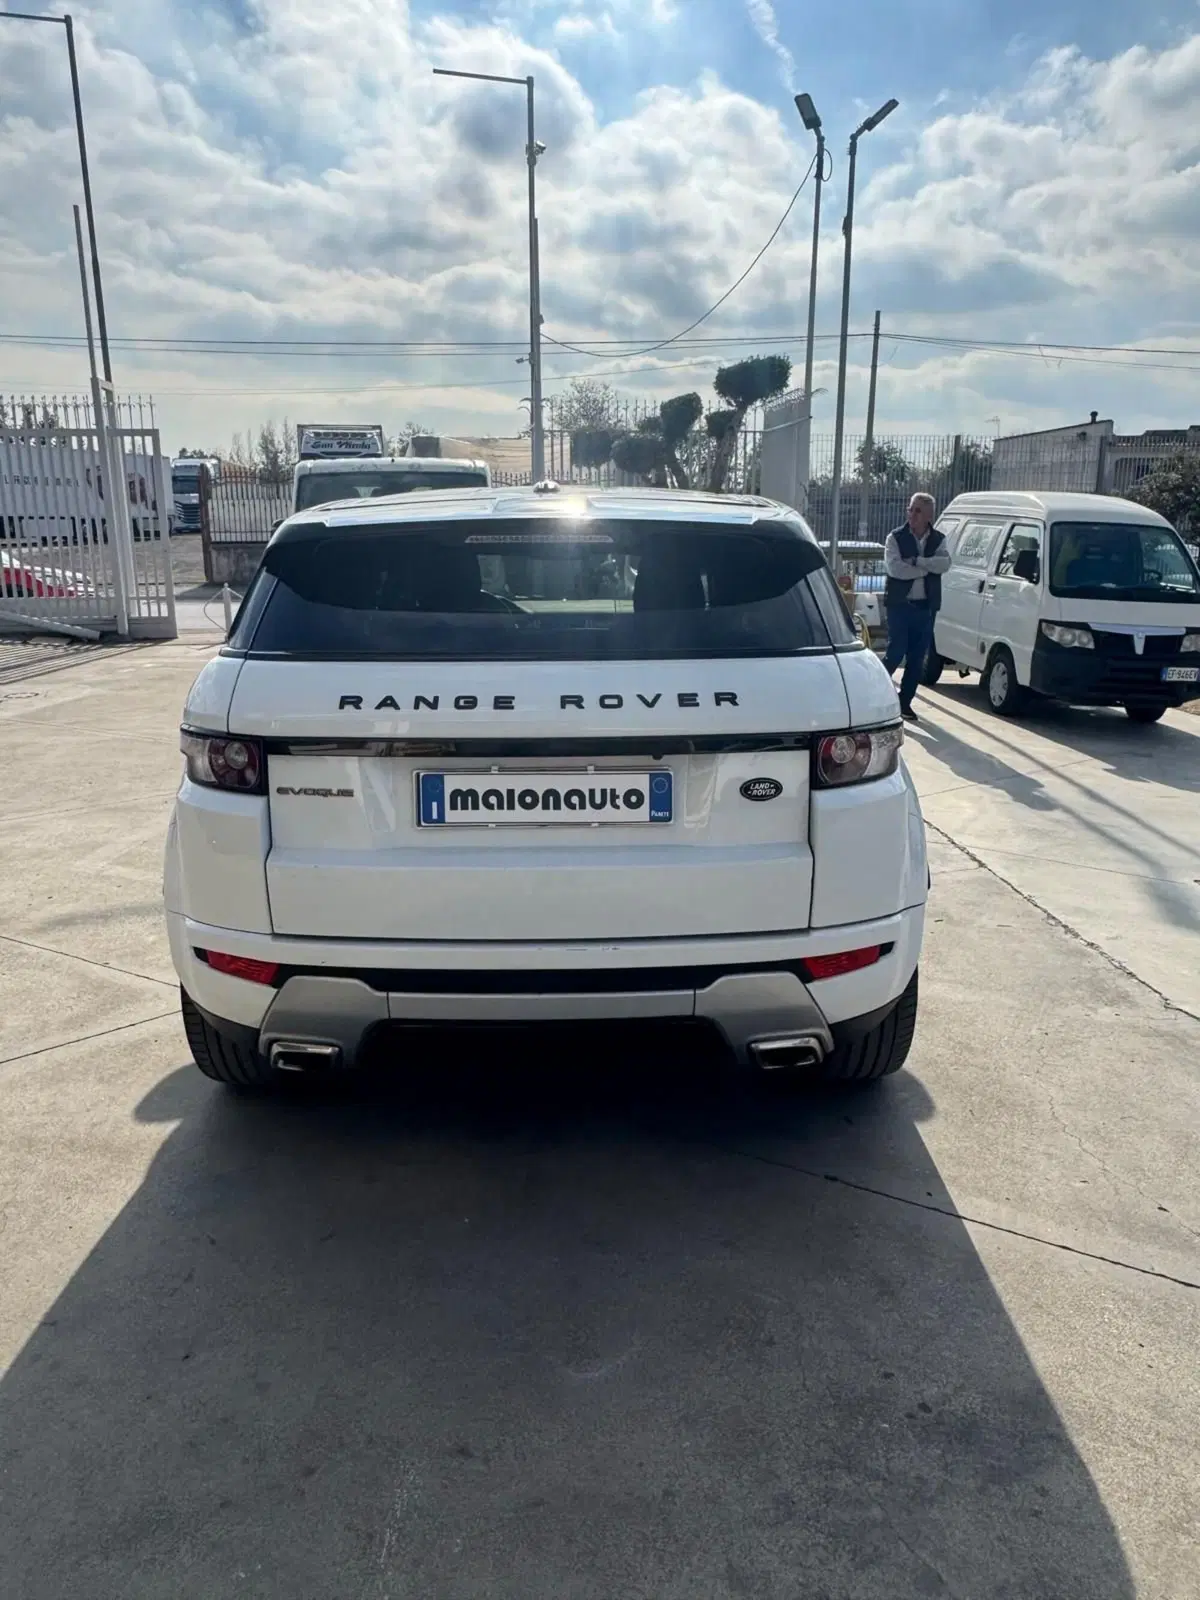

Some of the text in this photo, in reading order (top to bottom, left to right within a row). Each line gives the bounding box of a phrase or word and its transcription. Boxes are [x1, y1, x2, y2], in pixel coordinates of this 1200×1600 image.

[338, 691, 740, 710] RANGE ROVER
[276, 786, 354, 798] EVOQUE
